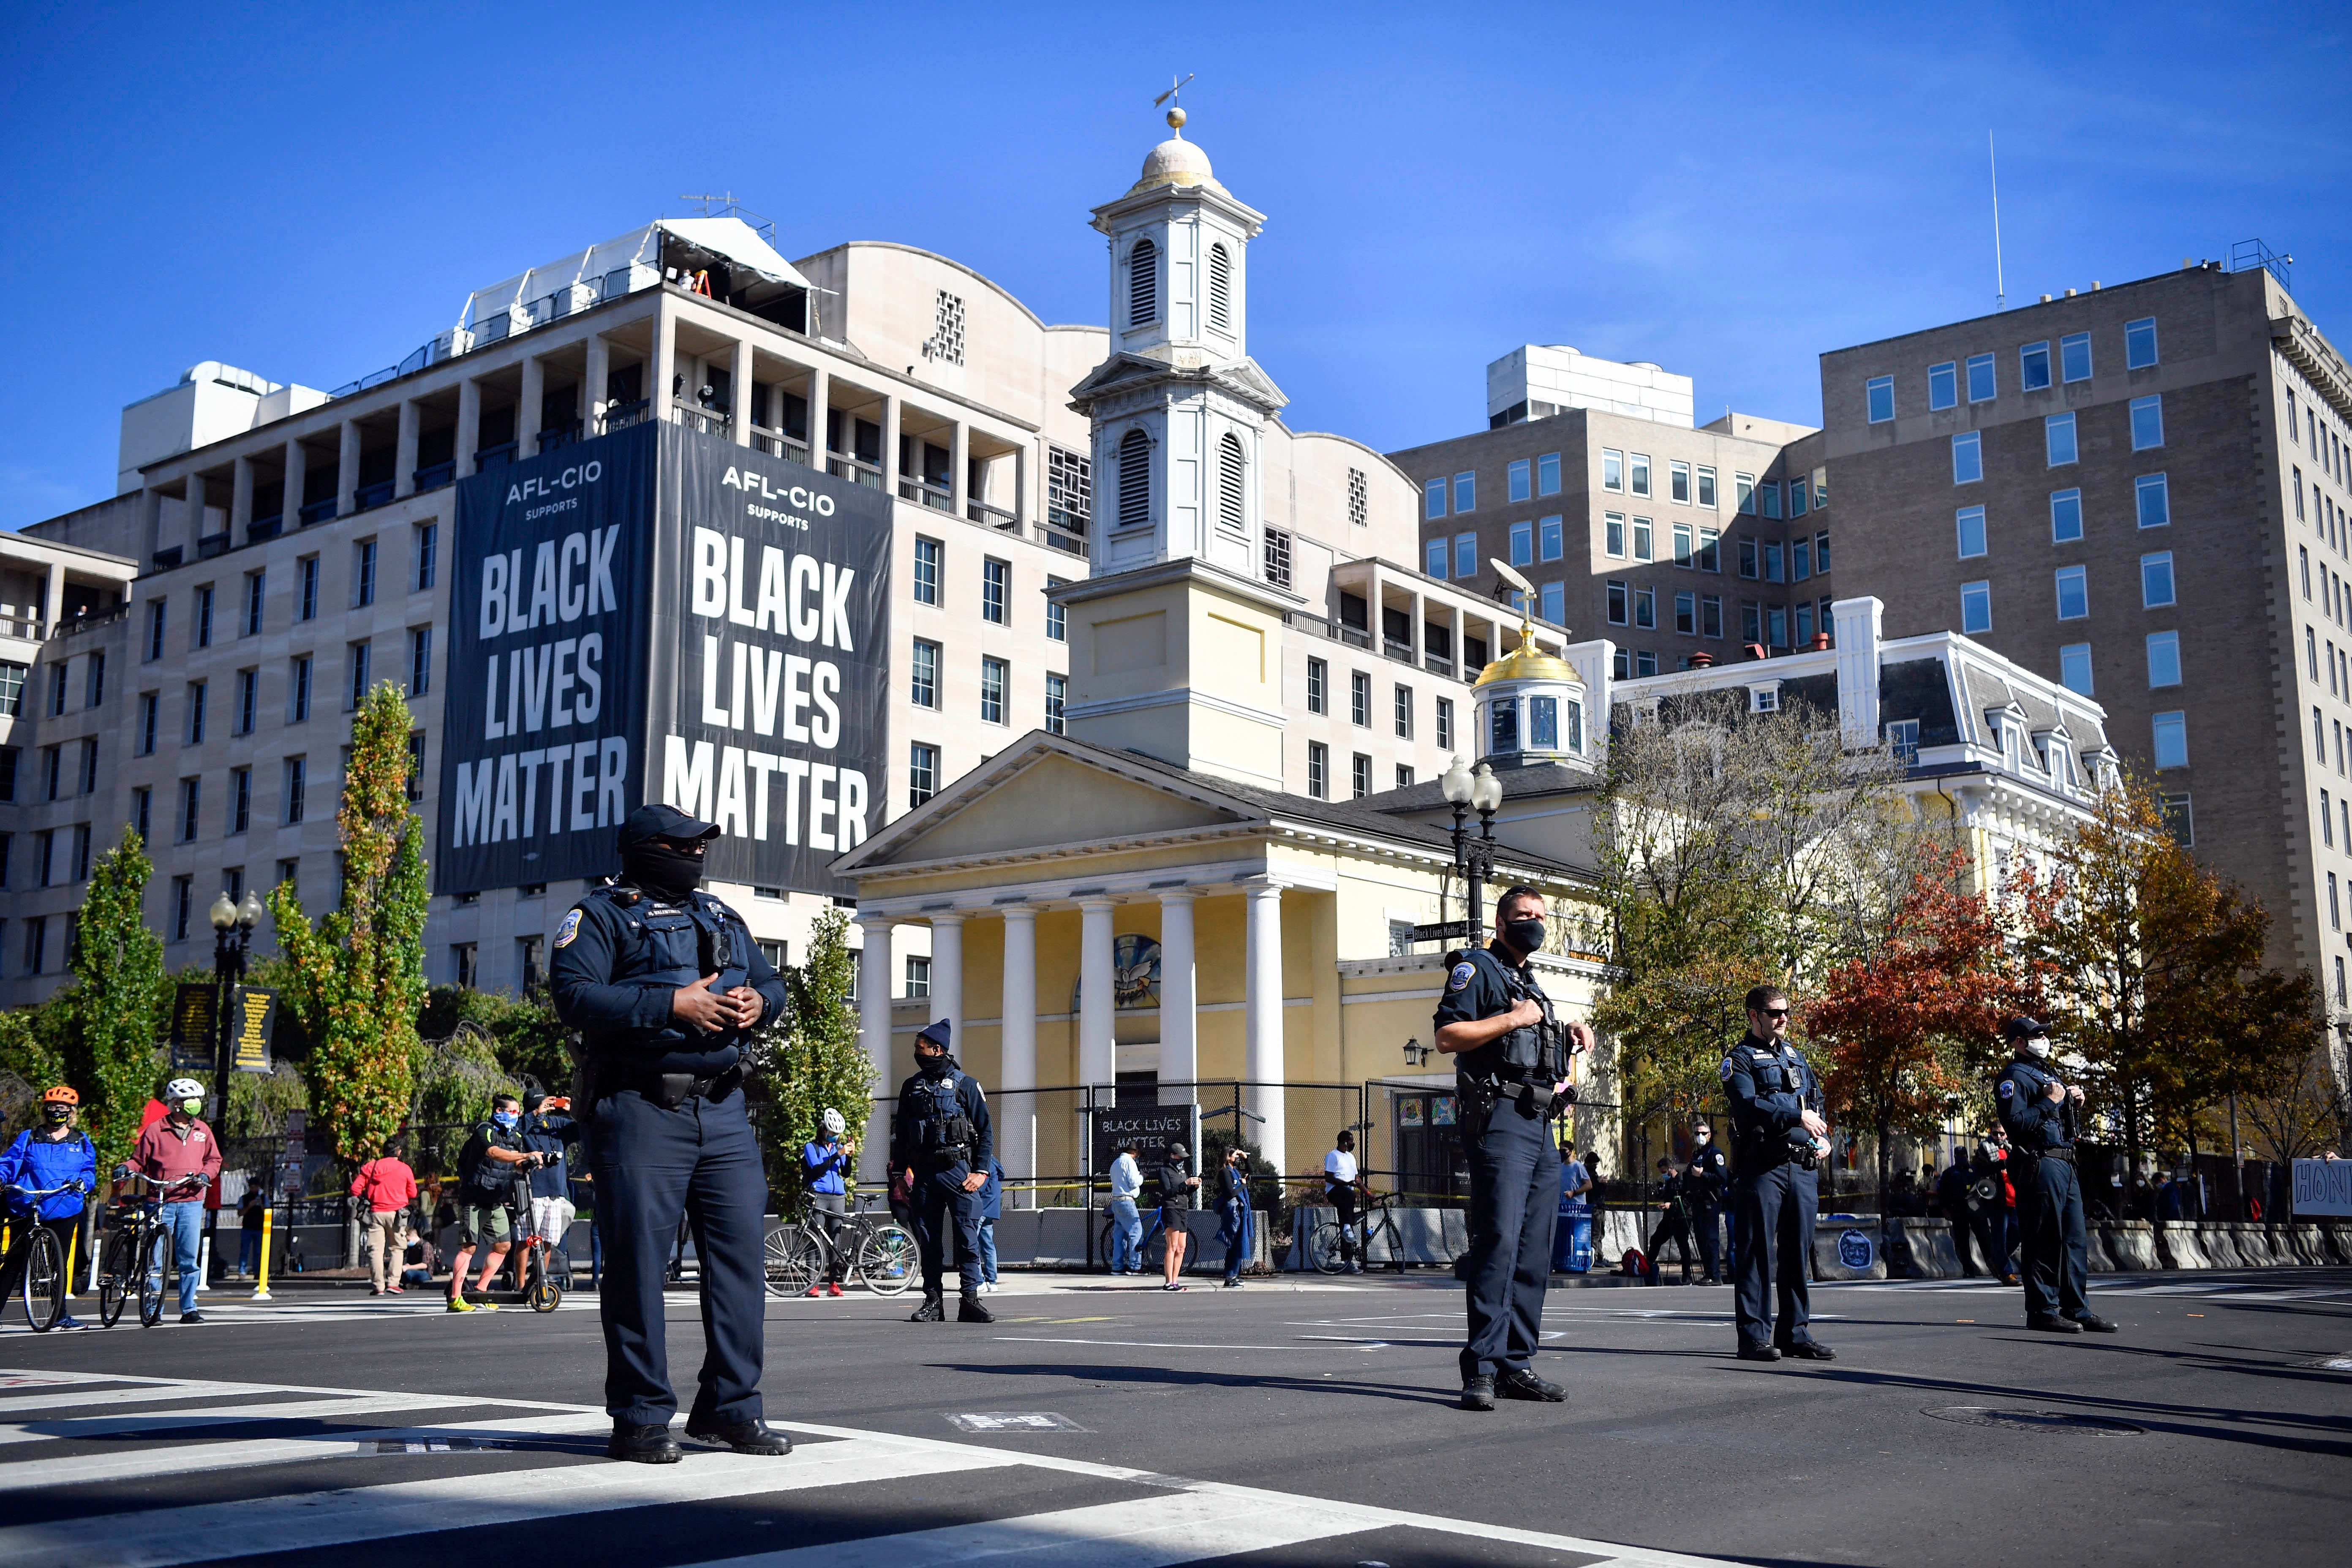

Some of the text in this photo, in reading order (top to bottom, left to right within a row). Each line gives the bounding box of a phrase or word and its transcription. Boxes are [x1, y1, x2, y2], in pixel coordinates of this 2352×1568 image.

[507, 460, 602, 505] AFL-CIO
[722, 466, 835, 517] AFL-CIO
[526, 497, 578, 520] SUPPORTS
[747, 504, 809, 531] SUPPORTS
[479, 523, 621, 640] BLACK
[691, 525, 855, 652] BLACK
[485, 632, 603, 741] LIVES
[702, 635, 841, 750] LIVES
[453, 735, 629, 848] MATTER
[662, 735, 869, 854] MATTER
[1415, 929, 1429, 939] Black
[1430, 927, 1443, 938] Lives
[1443, 926, 1459, 936] Matter
[1102, 1117, 1181, 1132] BLACK LIVES
[2295, 1164, 2352, 1205] HON
